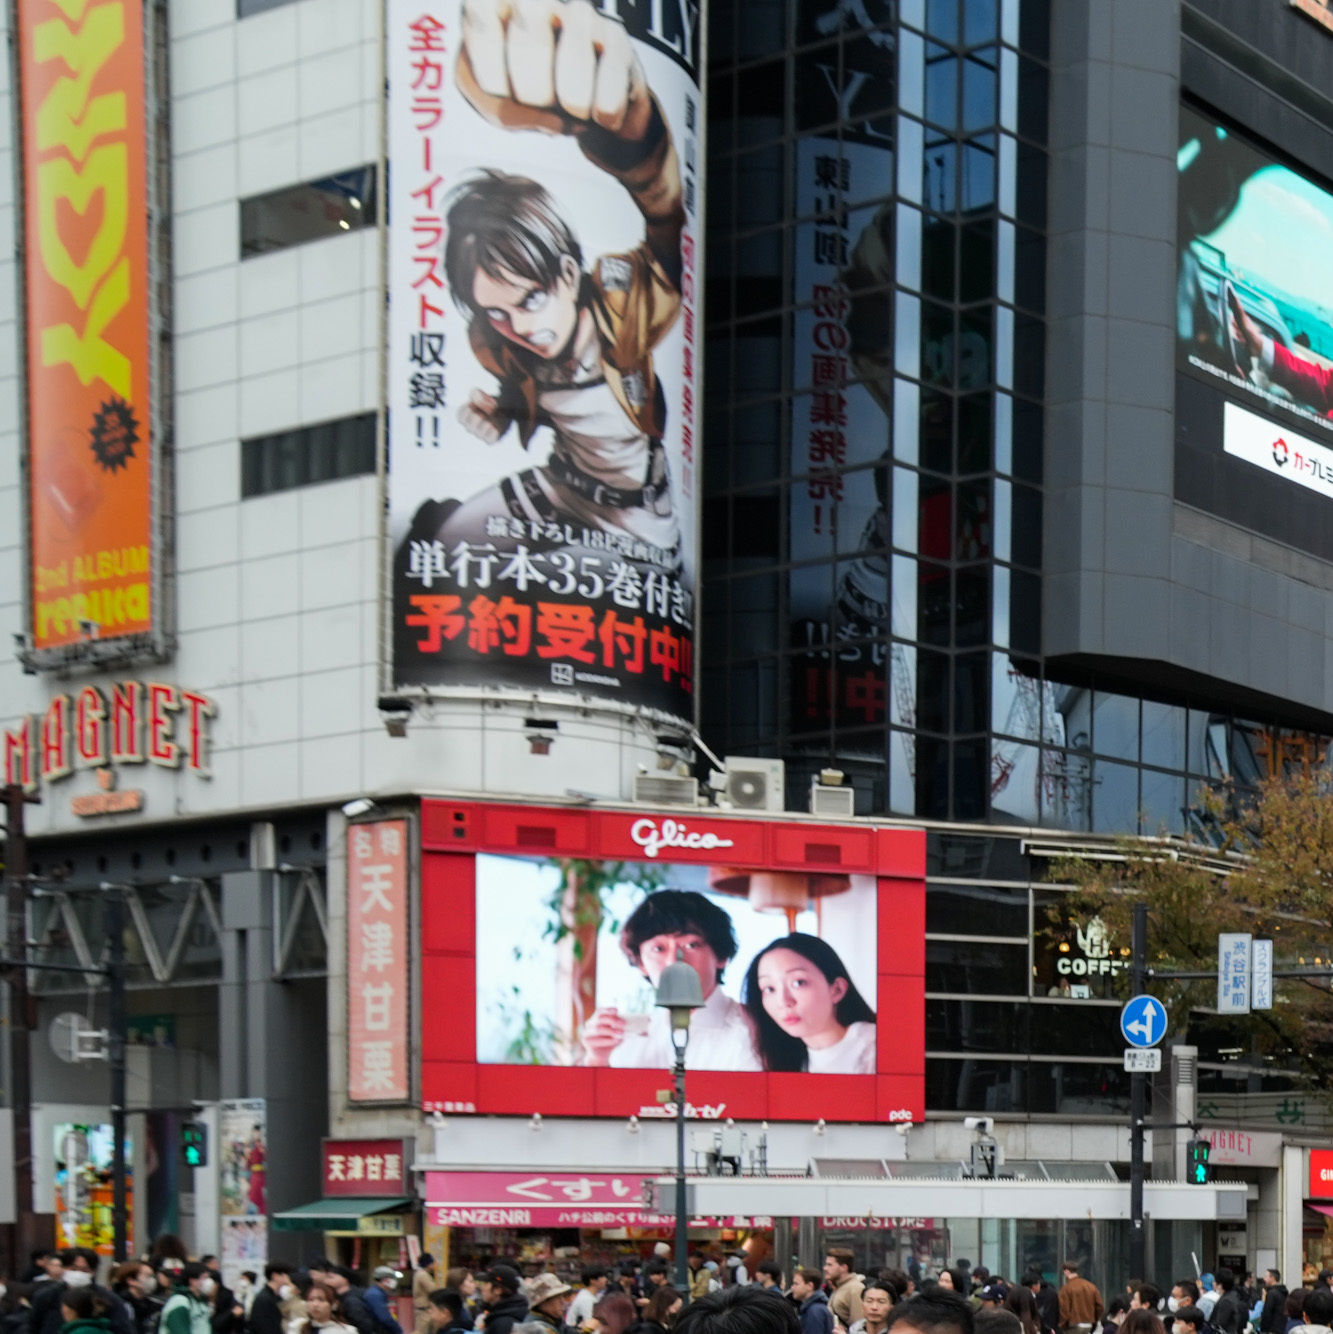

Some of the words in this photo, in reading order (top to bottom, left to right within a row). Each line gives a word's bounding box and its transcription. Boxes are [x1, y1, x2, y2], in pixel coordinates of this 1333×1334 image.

[34, 0, 132, 400] NDY
[408, 14, 447, 449] 全カラーイラスト収録!!
[73, 545, 149, 582] ALBUM
[405, 594, 692, 694] 予約受付中!!
[4, 681, 215, 793] MAGNET
[630, 818, 734, 858] Glico
[360, 864, 394, 1091] 天津甘栗
[1232, 941, 1247, 1007] 渋谷駅前
[328, 1154, 401, 1182] 天津甘栗
[437, 1208, 531, 1226] SANZENRI
